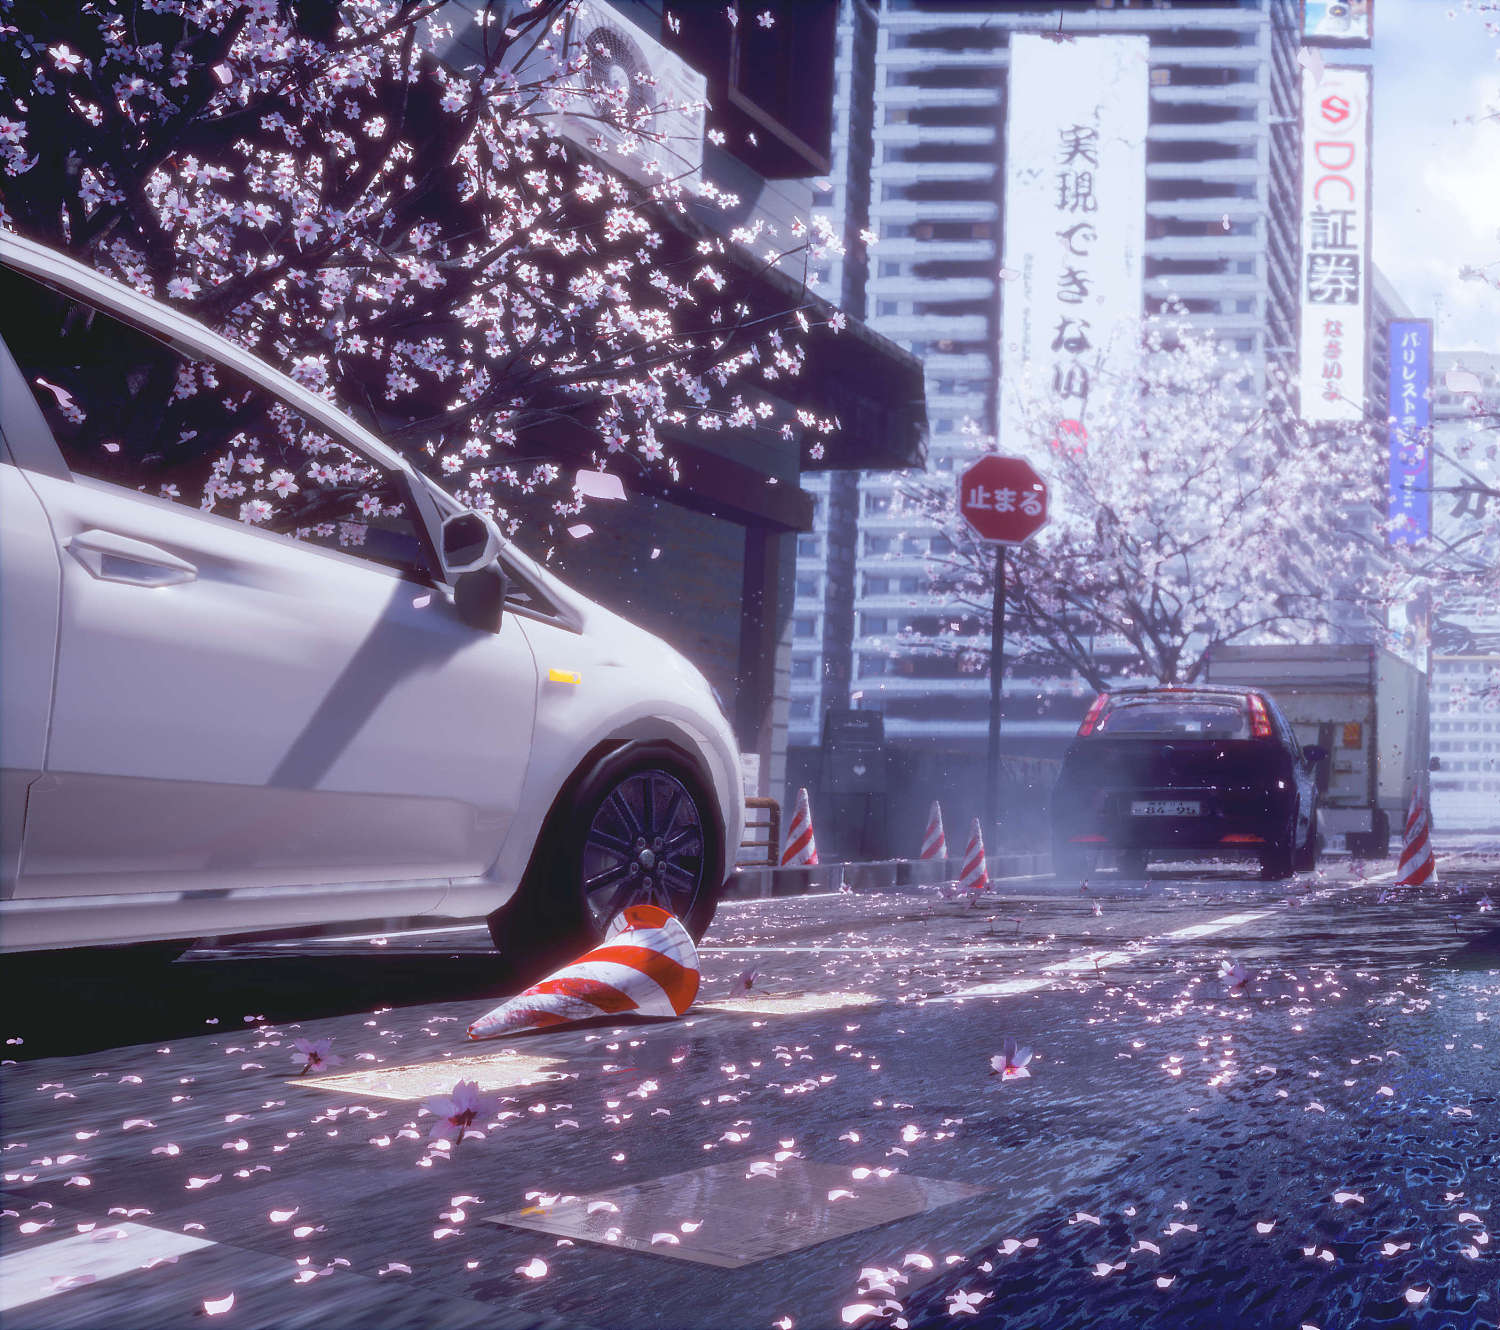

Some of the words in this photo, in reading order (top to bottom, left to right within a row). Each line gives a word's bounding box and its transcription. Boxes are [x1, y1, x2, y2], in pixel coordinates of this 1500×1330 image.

[1052, 123, 1099, 404] 実現できない
[966, 485, 1043, 516] 止まる
